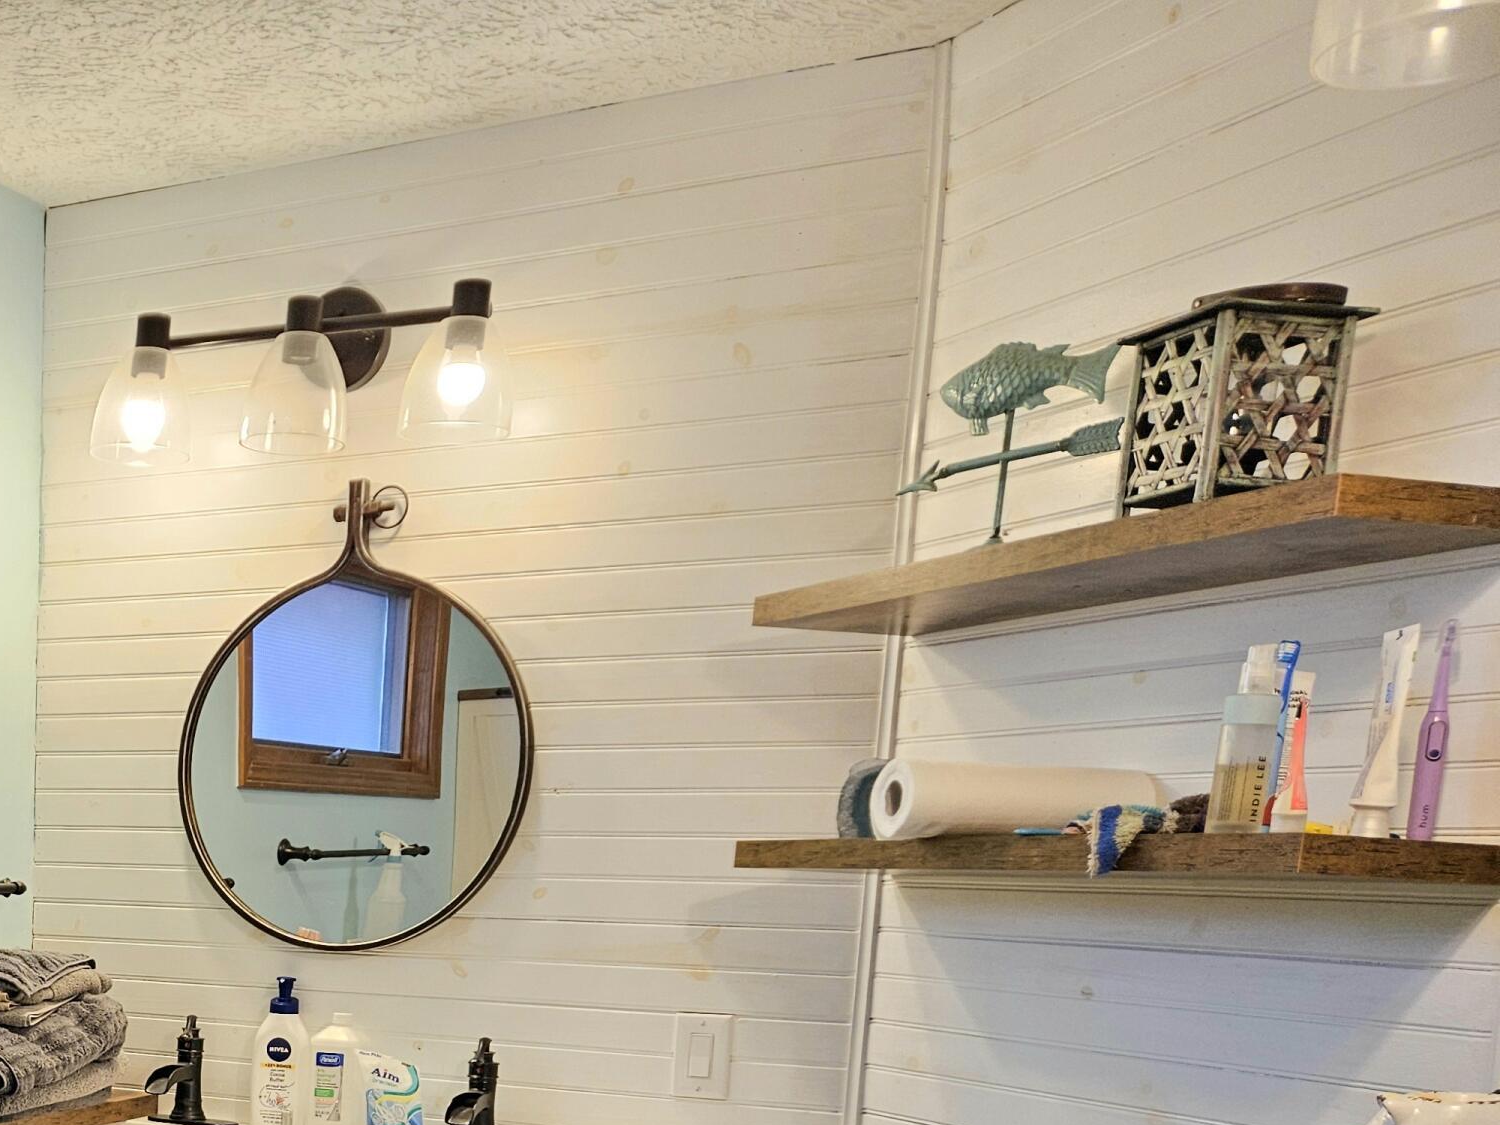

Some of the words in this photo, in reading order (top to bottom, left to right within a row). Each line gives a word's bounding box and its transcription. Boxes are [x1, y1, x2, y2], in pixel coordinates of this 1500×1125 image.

[1249, 784, 1263, 822] INDIE
[1256, 755, 1267, 779] LEE
[1419, 804, 1430, 828] hum
[371, 1067, 400, 1083] Aim
